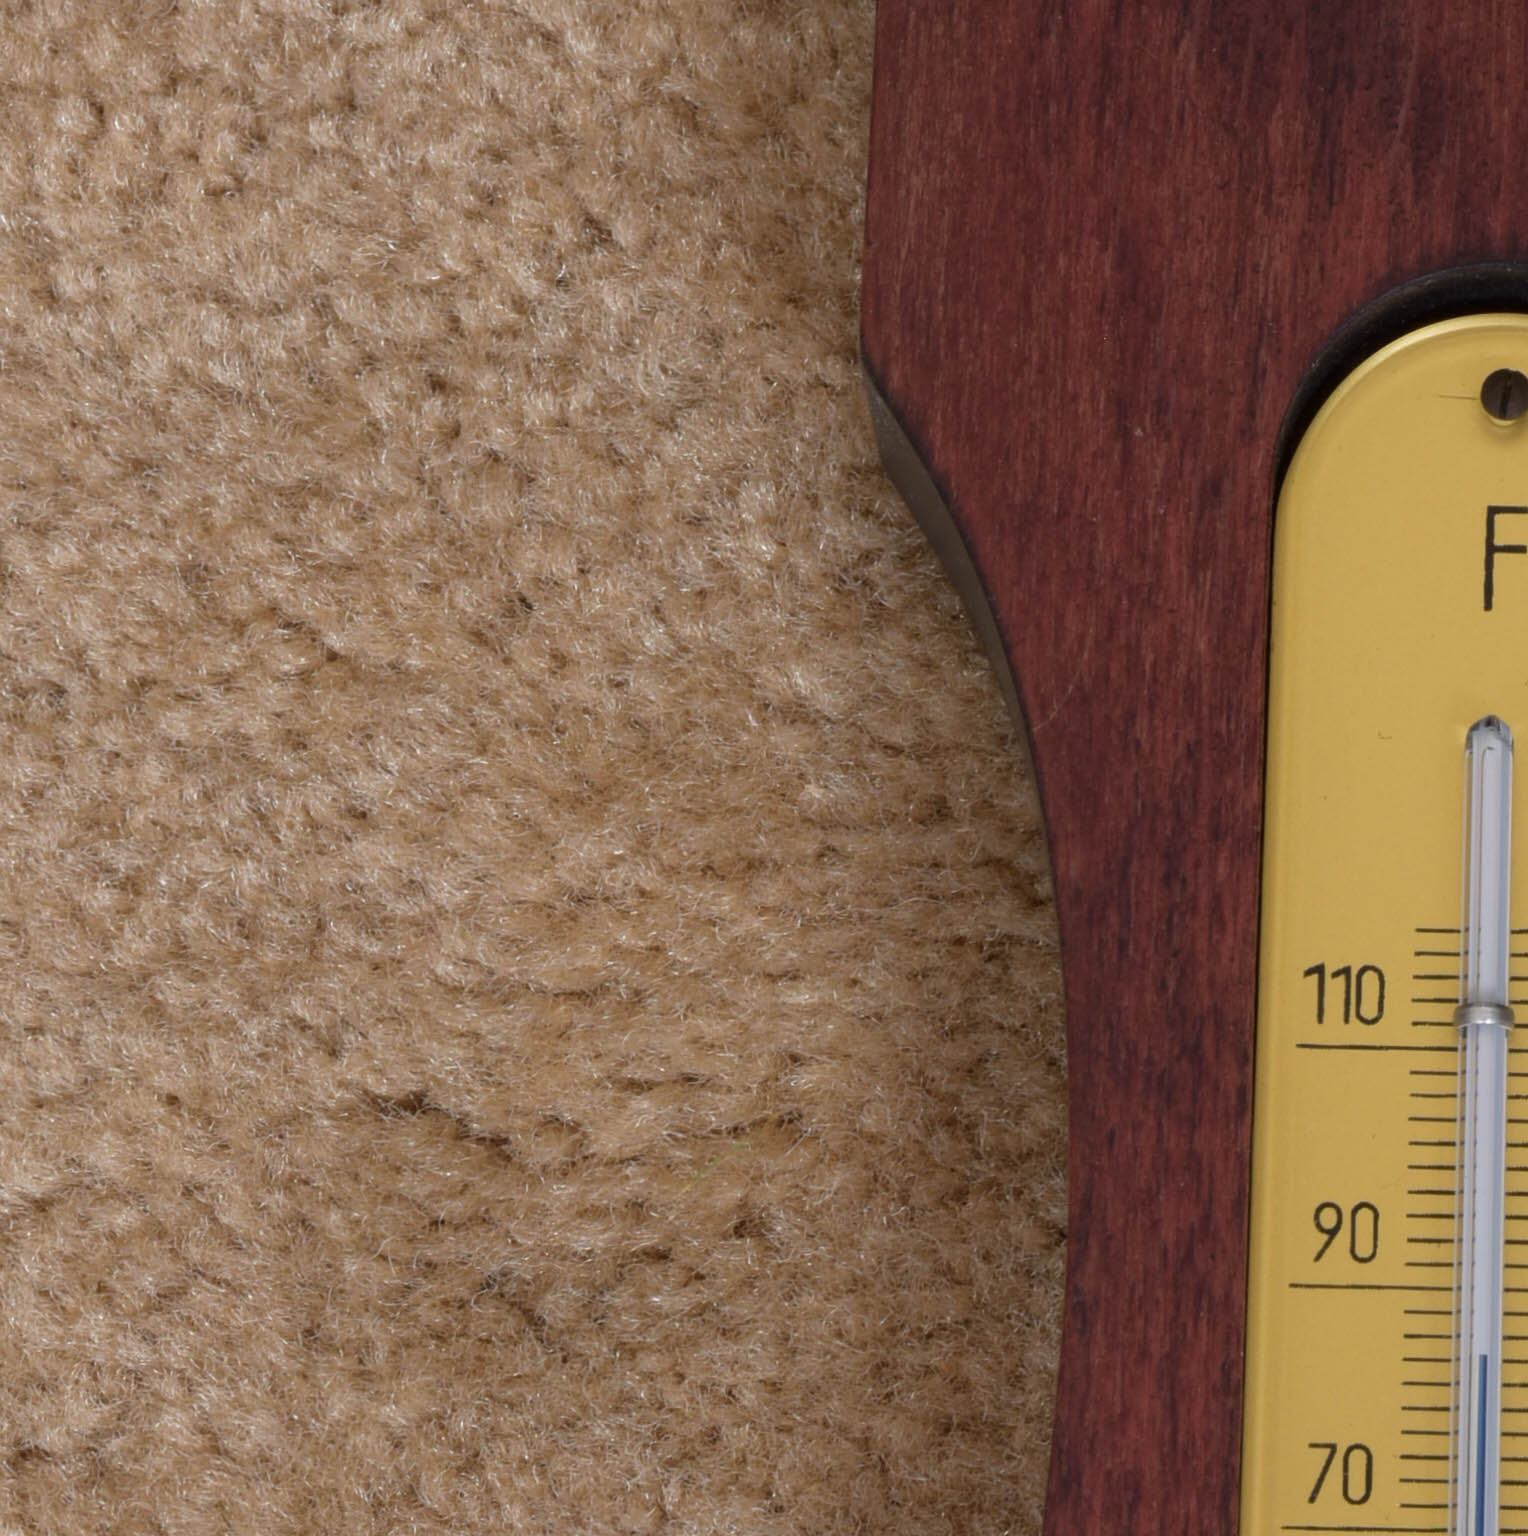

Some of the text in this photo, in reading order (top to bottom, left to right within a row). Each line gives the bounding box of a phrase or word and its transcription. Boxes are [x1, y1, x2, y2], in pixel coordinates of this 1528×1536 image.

[1484, 505, 1528, 611] F
[1304, 963, 1385, 1025] 110
[1314, 1202, 1379, 1263] 90
[1308, 1443, 1373, 1505] 70
